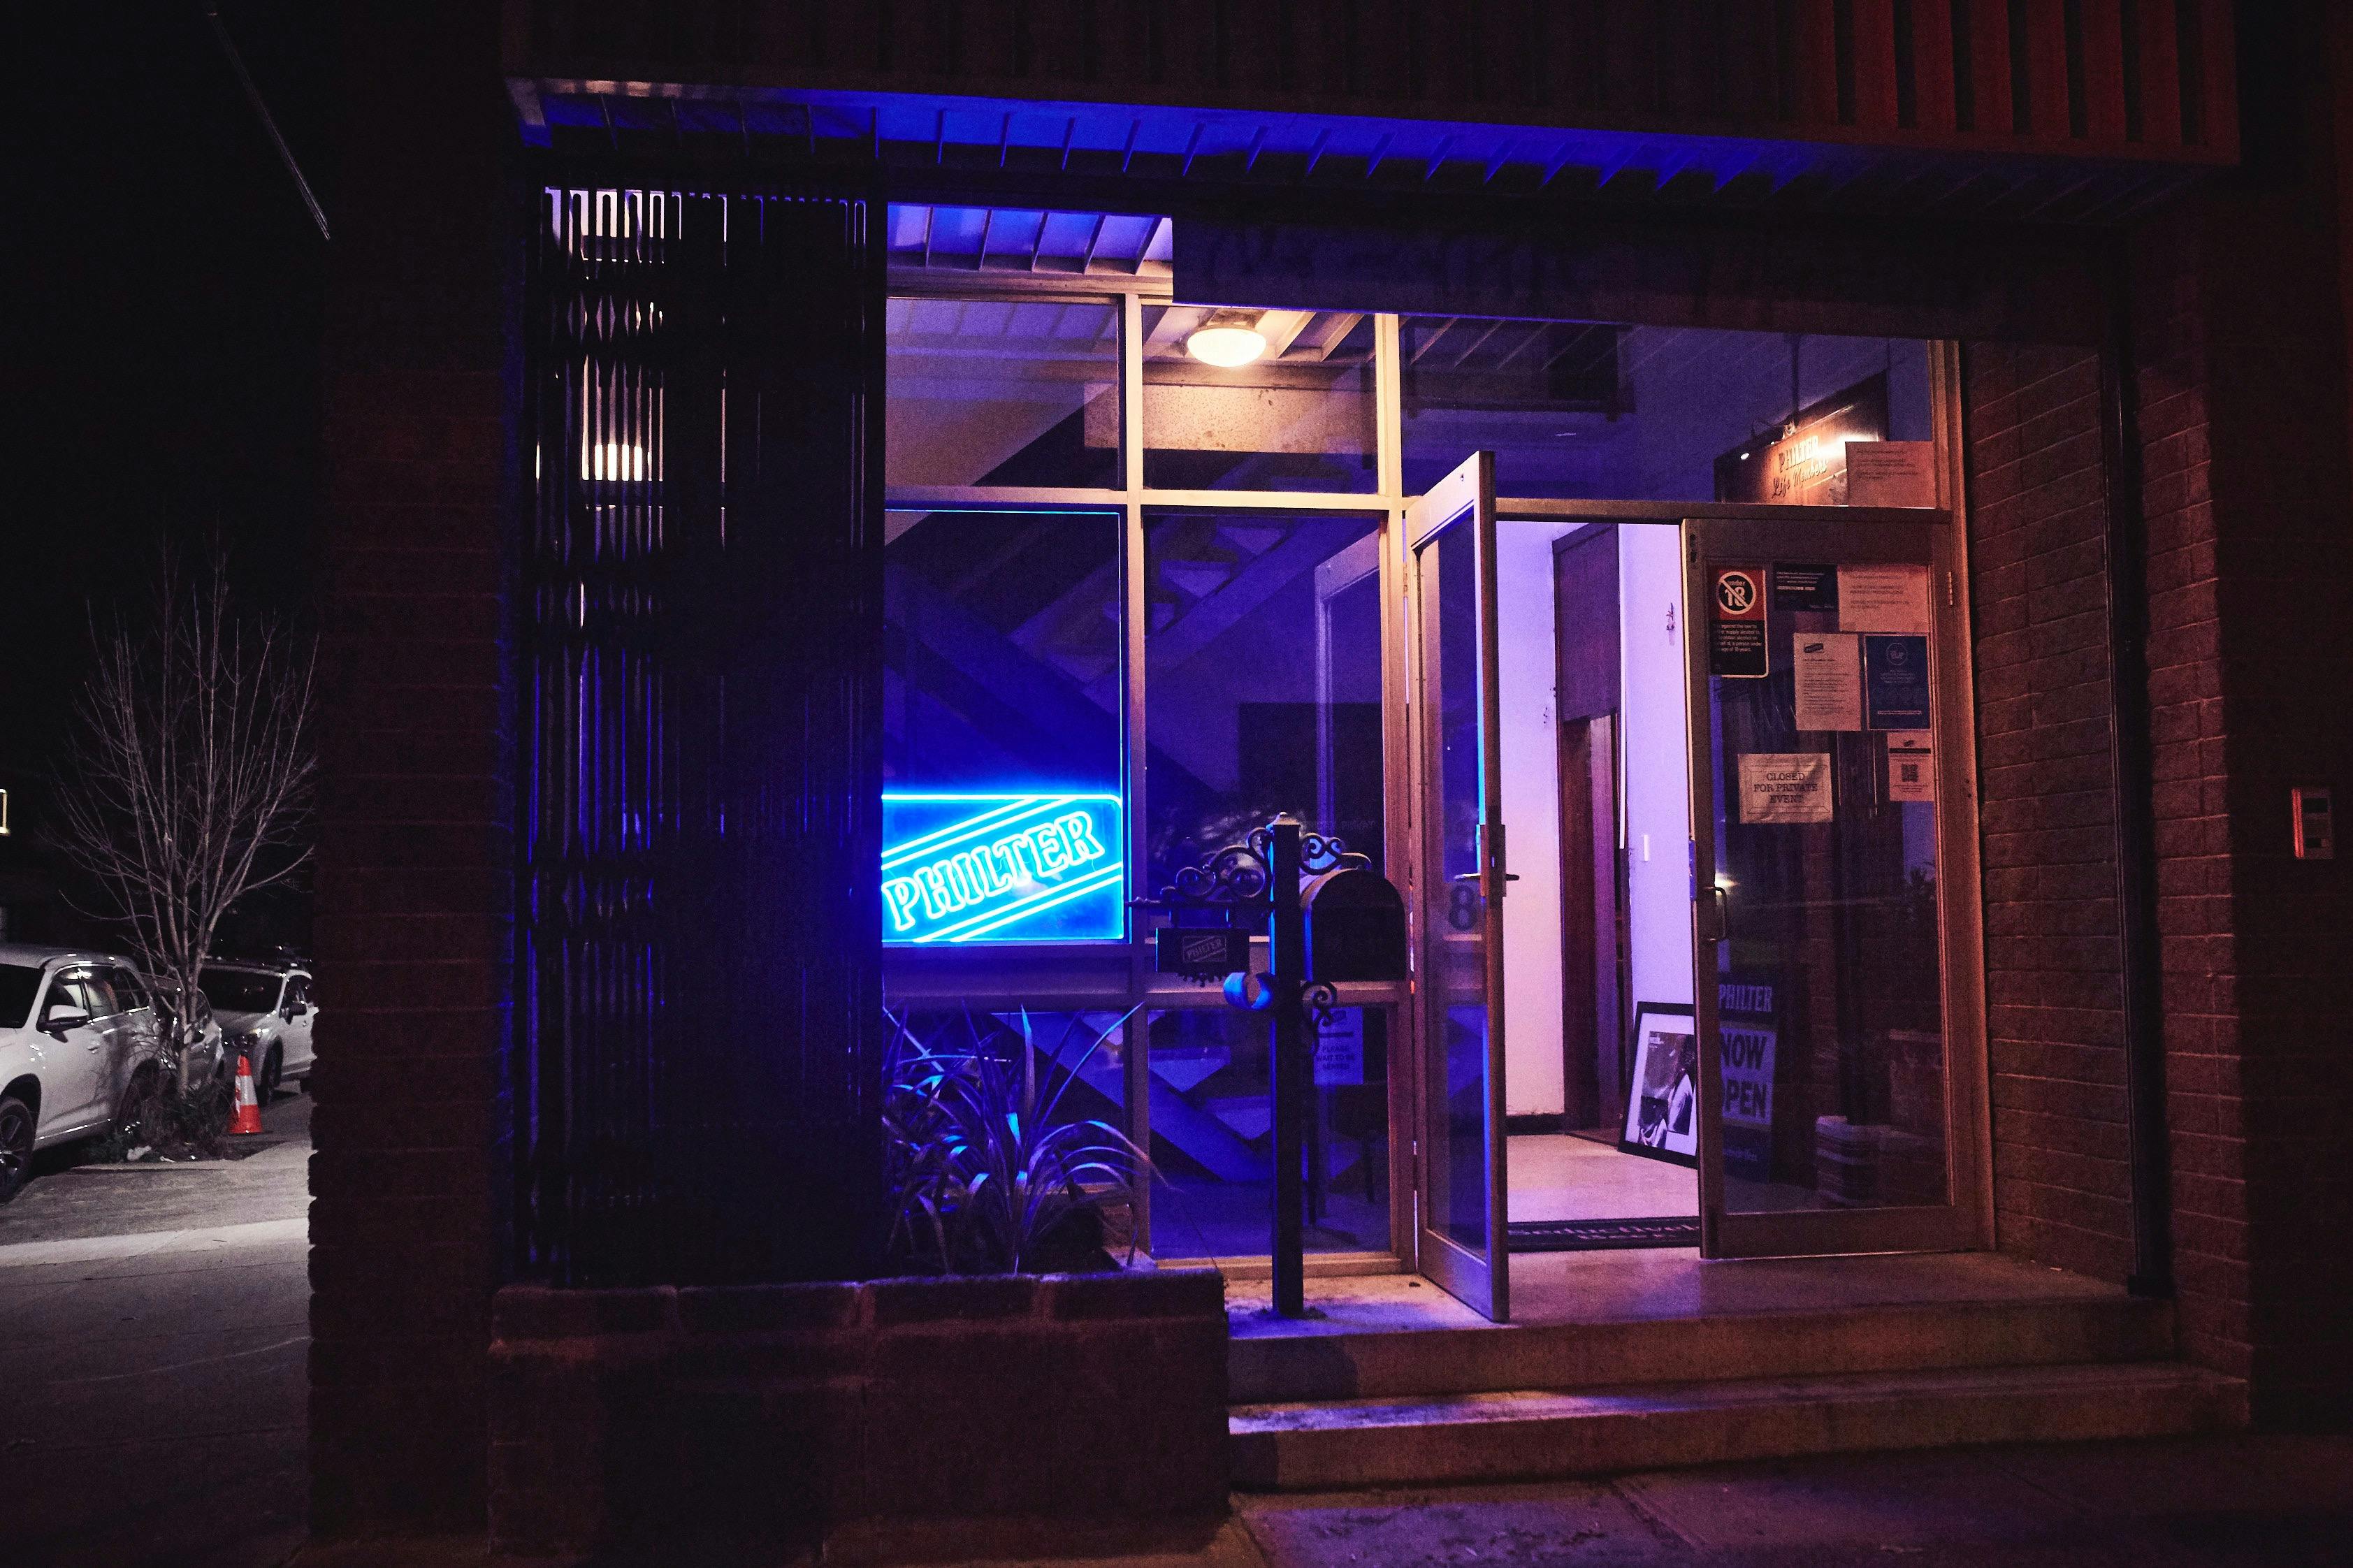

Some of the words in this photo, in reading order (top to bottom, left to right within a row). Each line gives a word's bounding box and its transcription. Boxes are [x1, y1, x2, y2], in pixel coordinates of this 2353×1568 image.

[1724, 586, 1746, 607] 18
[1753, 784, 1774, 792] FOR
[1776, 783, 1818, 792] PRIVATE
[1766, 772, 1805, 781] CLOSED
[1769, 794, 1804, 804] EVENT
[881, 811, 1105, 931] PHILTER
[1187, 938, 1222, 960] PHILTER
[1718, 984, 1773, 1012] PHILTER
[1719, 1032, 1767, 1070] NOW
[1723, 1077, 1767, 1119] PEN
